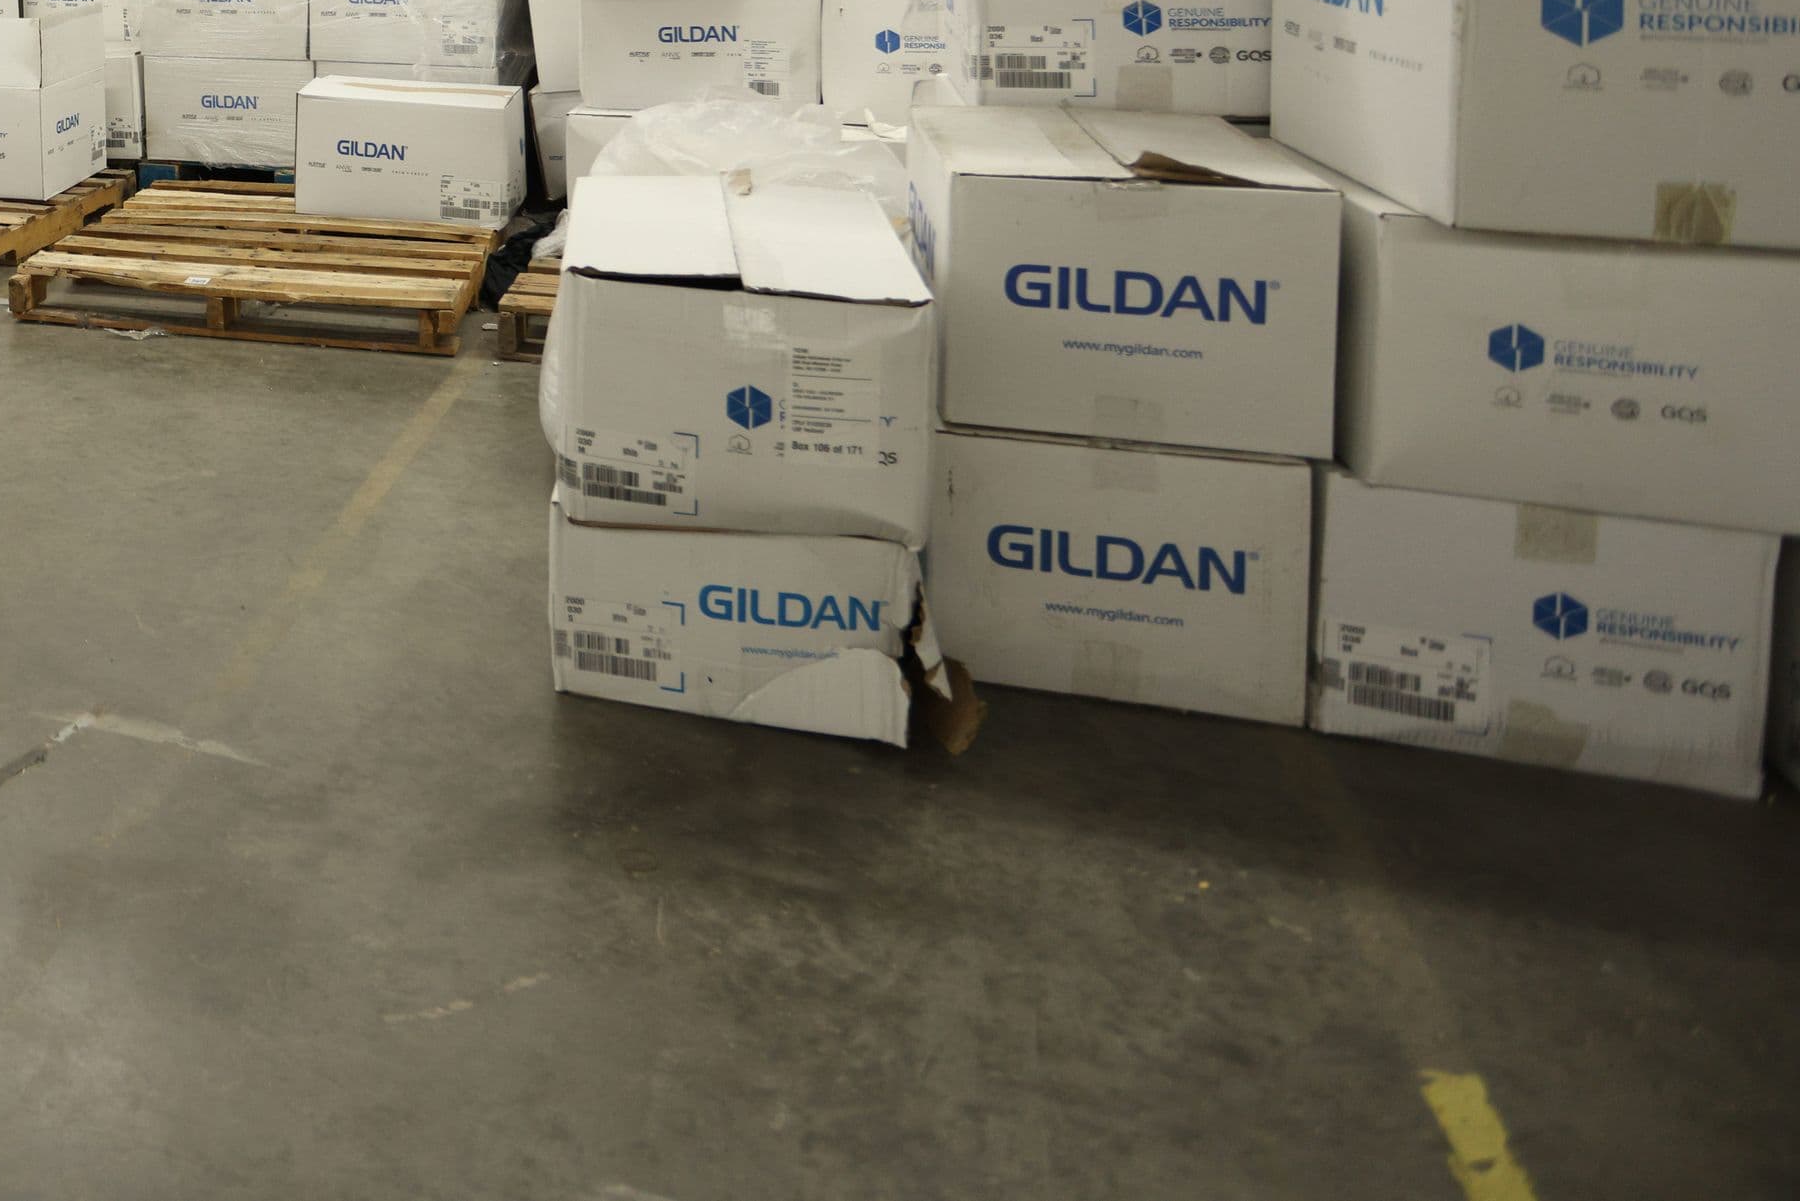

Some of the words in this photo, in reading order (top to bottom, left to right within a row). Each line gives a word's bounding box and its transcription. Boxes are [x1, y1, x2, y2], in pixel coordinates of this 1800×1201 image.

[1168, 8, 1224, 17] GENUINE
[1169, 17, 1271, 28] RESPONSIBILITY
[1640, 14, 1799, 34] RESPONSIBI
[658, 25, 738, 44] GILDAN
[201, 95, 257, 111] GILDAN
[336, 139, 405, 160] GILDAN
[1063, 340, 1202, 360] www.mygildan.com
[1555, 340, 1634, 357] GENUINE
[1555, 355, 1697, 379] RESPONSIBILITY
[698, 584, 881, 631] GILDAN
[1045, 601, 1184, 628] www.mygildan.com
[1597, 622, 1740, 651] RESPONSIBILITY
